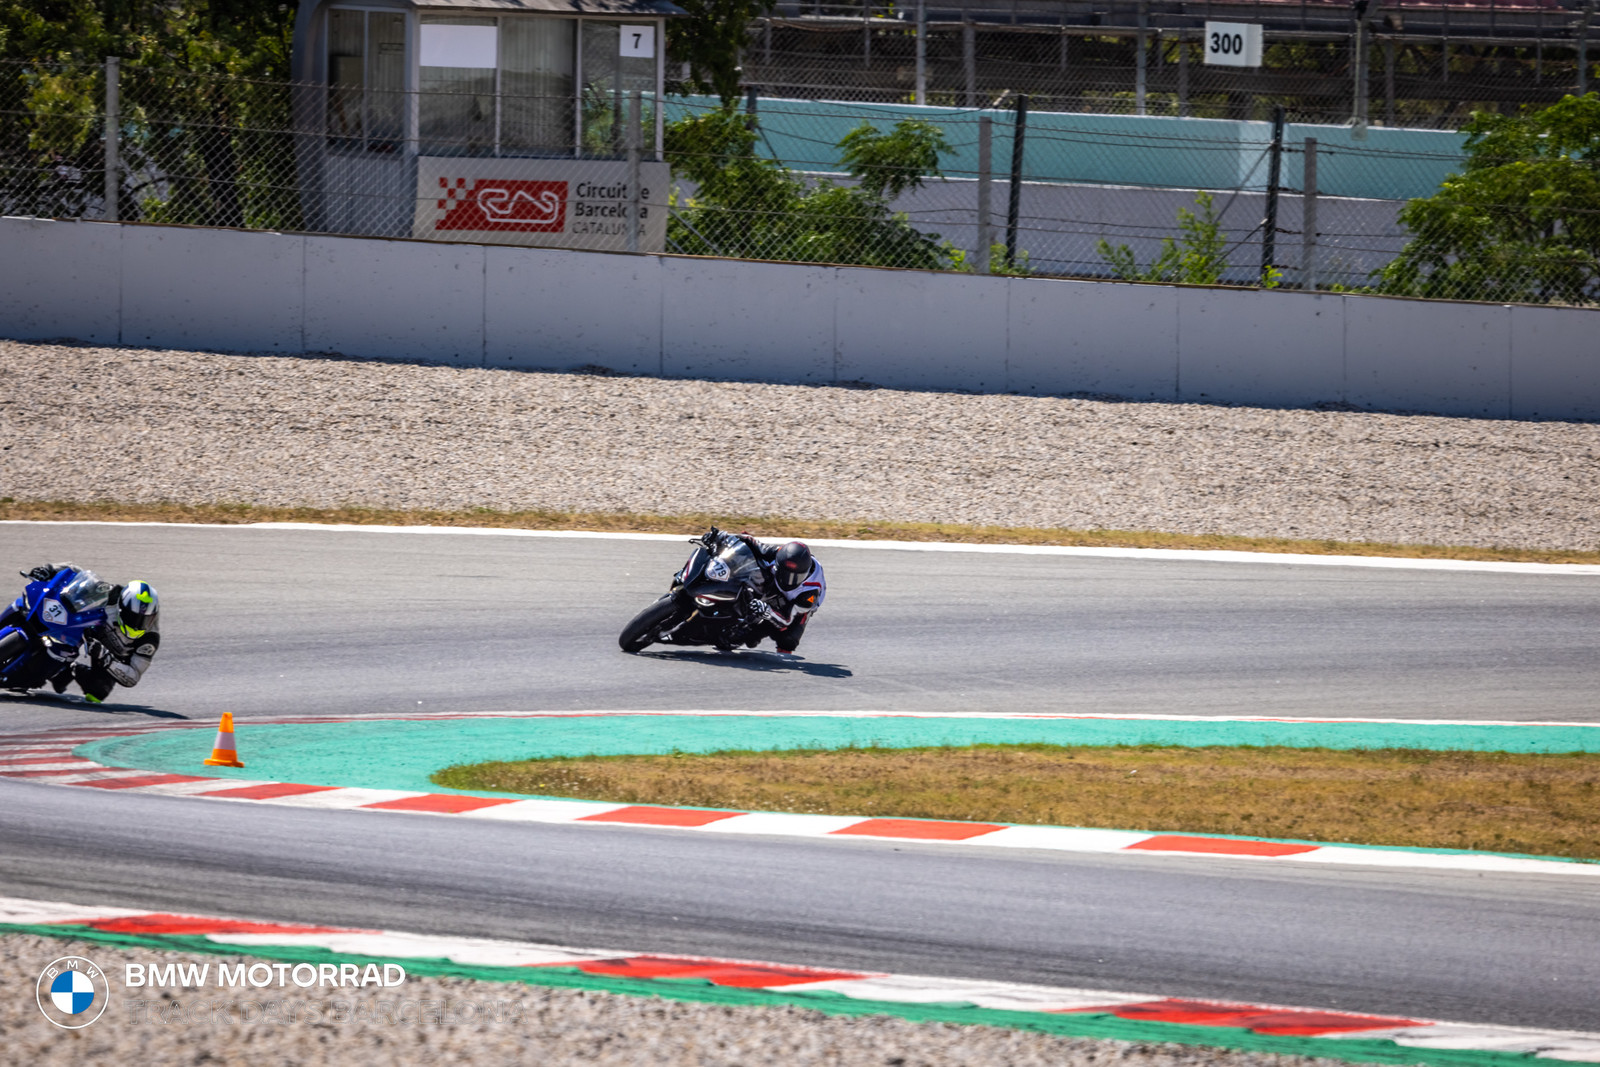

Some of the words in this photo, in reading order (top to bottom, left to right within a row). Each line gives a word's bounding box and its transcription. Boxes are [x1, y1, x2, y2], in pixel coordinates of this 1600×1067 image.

[632, 33, 642, 49] 7
[1210, 32, 1243, 55] 300
[576, 181, 628, 199] Circuit
